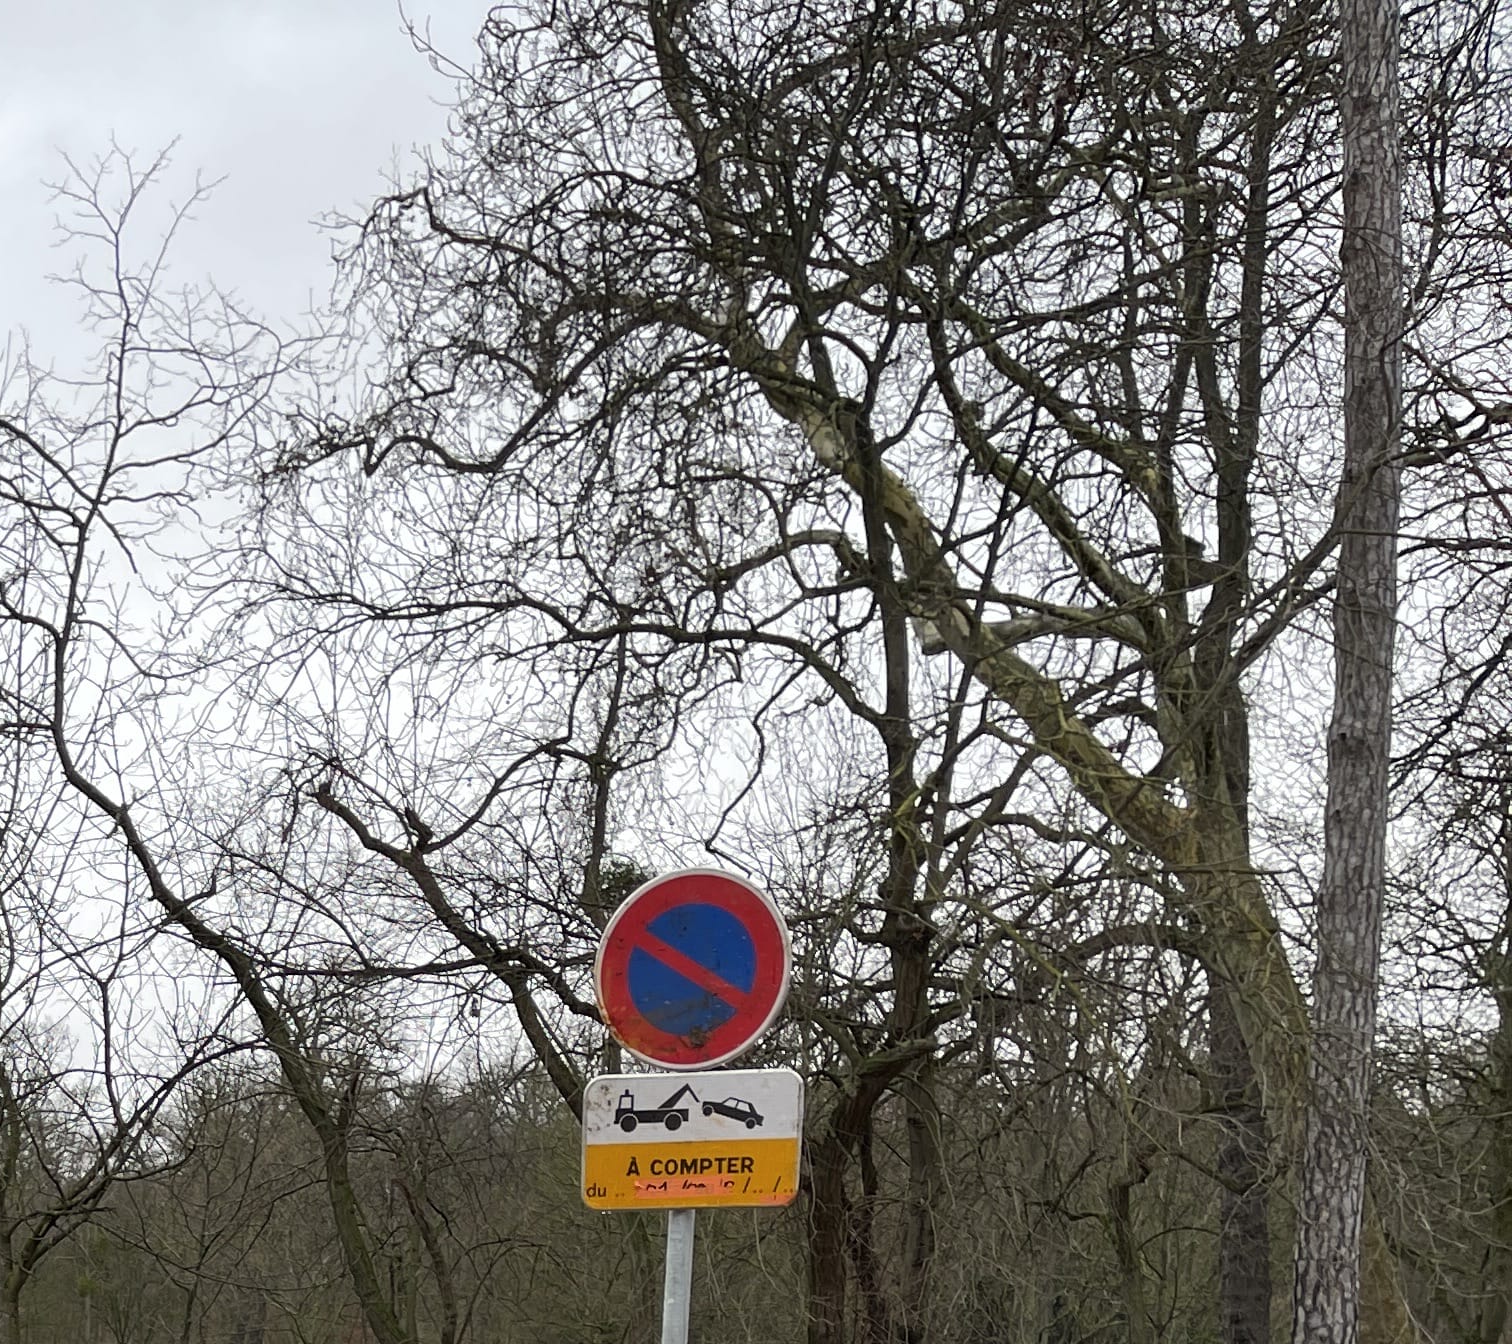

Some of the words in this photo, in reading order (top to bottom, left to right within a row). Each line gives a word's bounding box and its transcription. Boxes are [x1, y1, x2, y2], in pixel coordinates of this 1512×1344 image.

[626, 1156, 640, 1176] À
[650, 1157, 754, 1176] COMPTER
[586, 1183, 607, 1198] du
